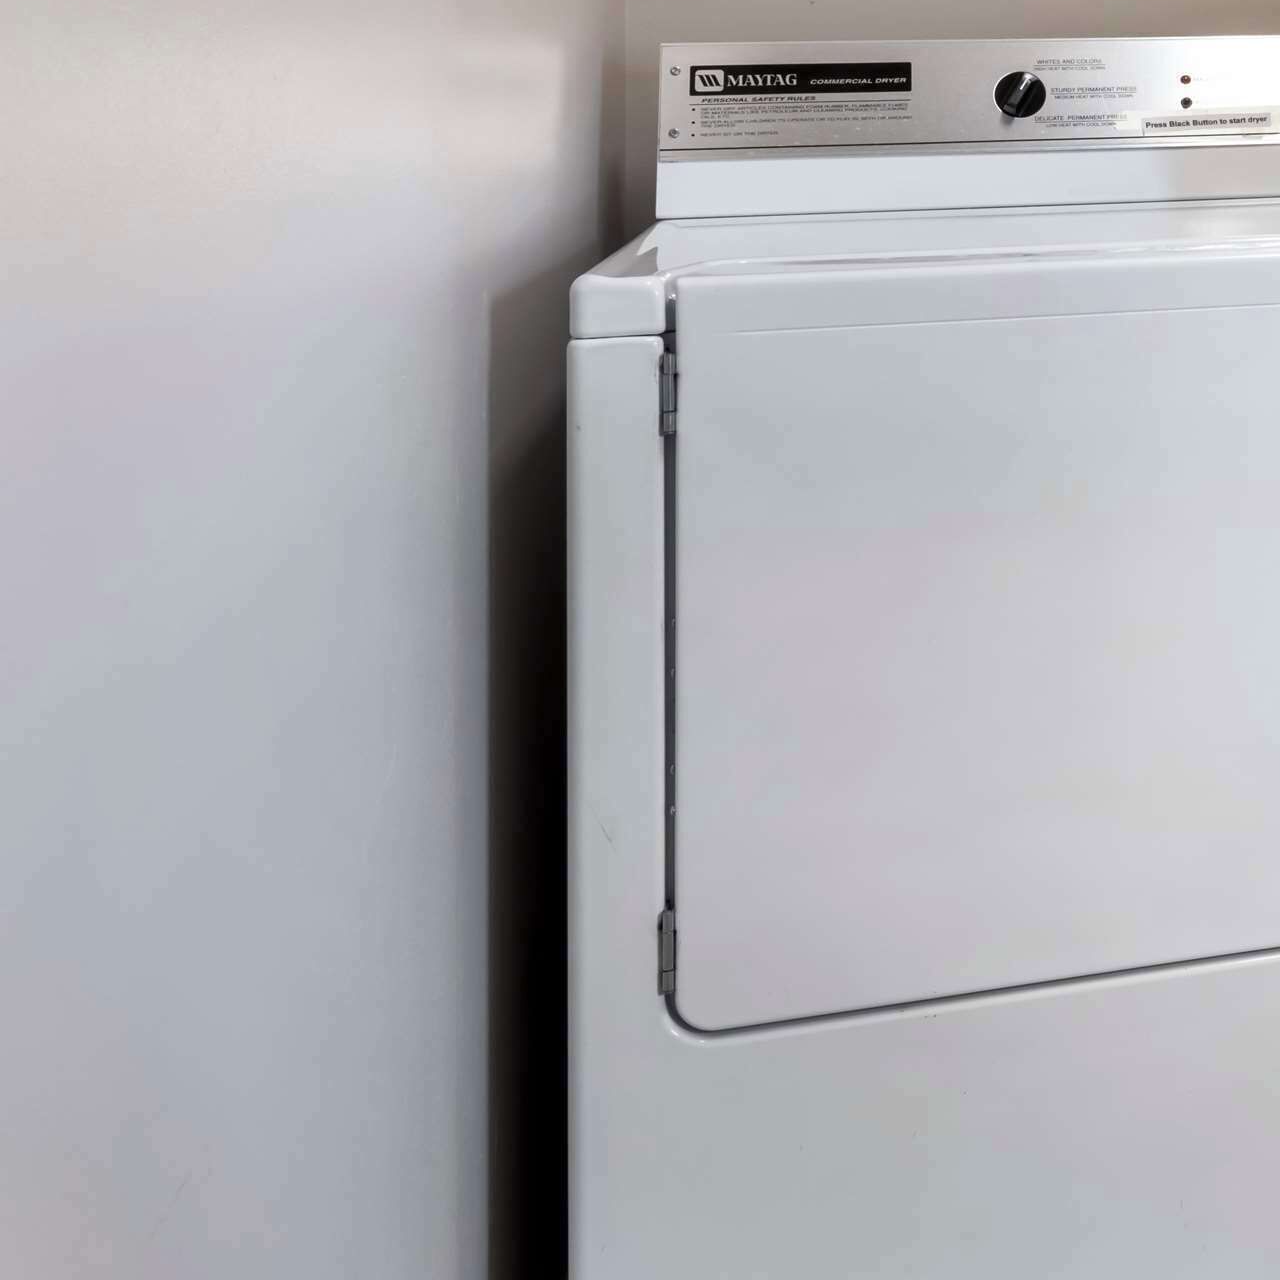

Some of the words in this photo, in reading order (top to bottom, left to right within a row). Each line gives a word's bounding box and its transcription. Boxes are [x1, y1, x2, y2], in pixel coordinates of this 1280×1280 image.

[727, 73, 798, 87] MAYTAG
[1145, 121, 1167, 129] Press
[1169, 119, 1191, 128] Black
[1247, 115, 1268, 124] dryer
